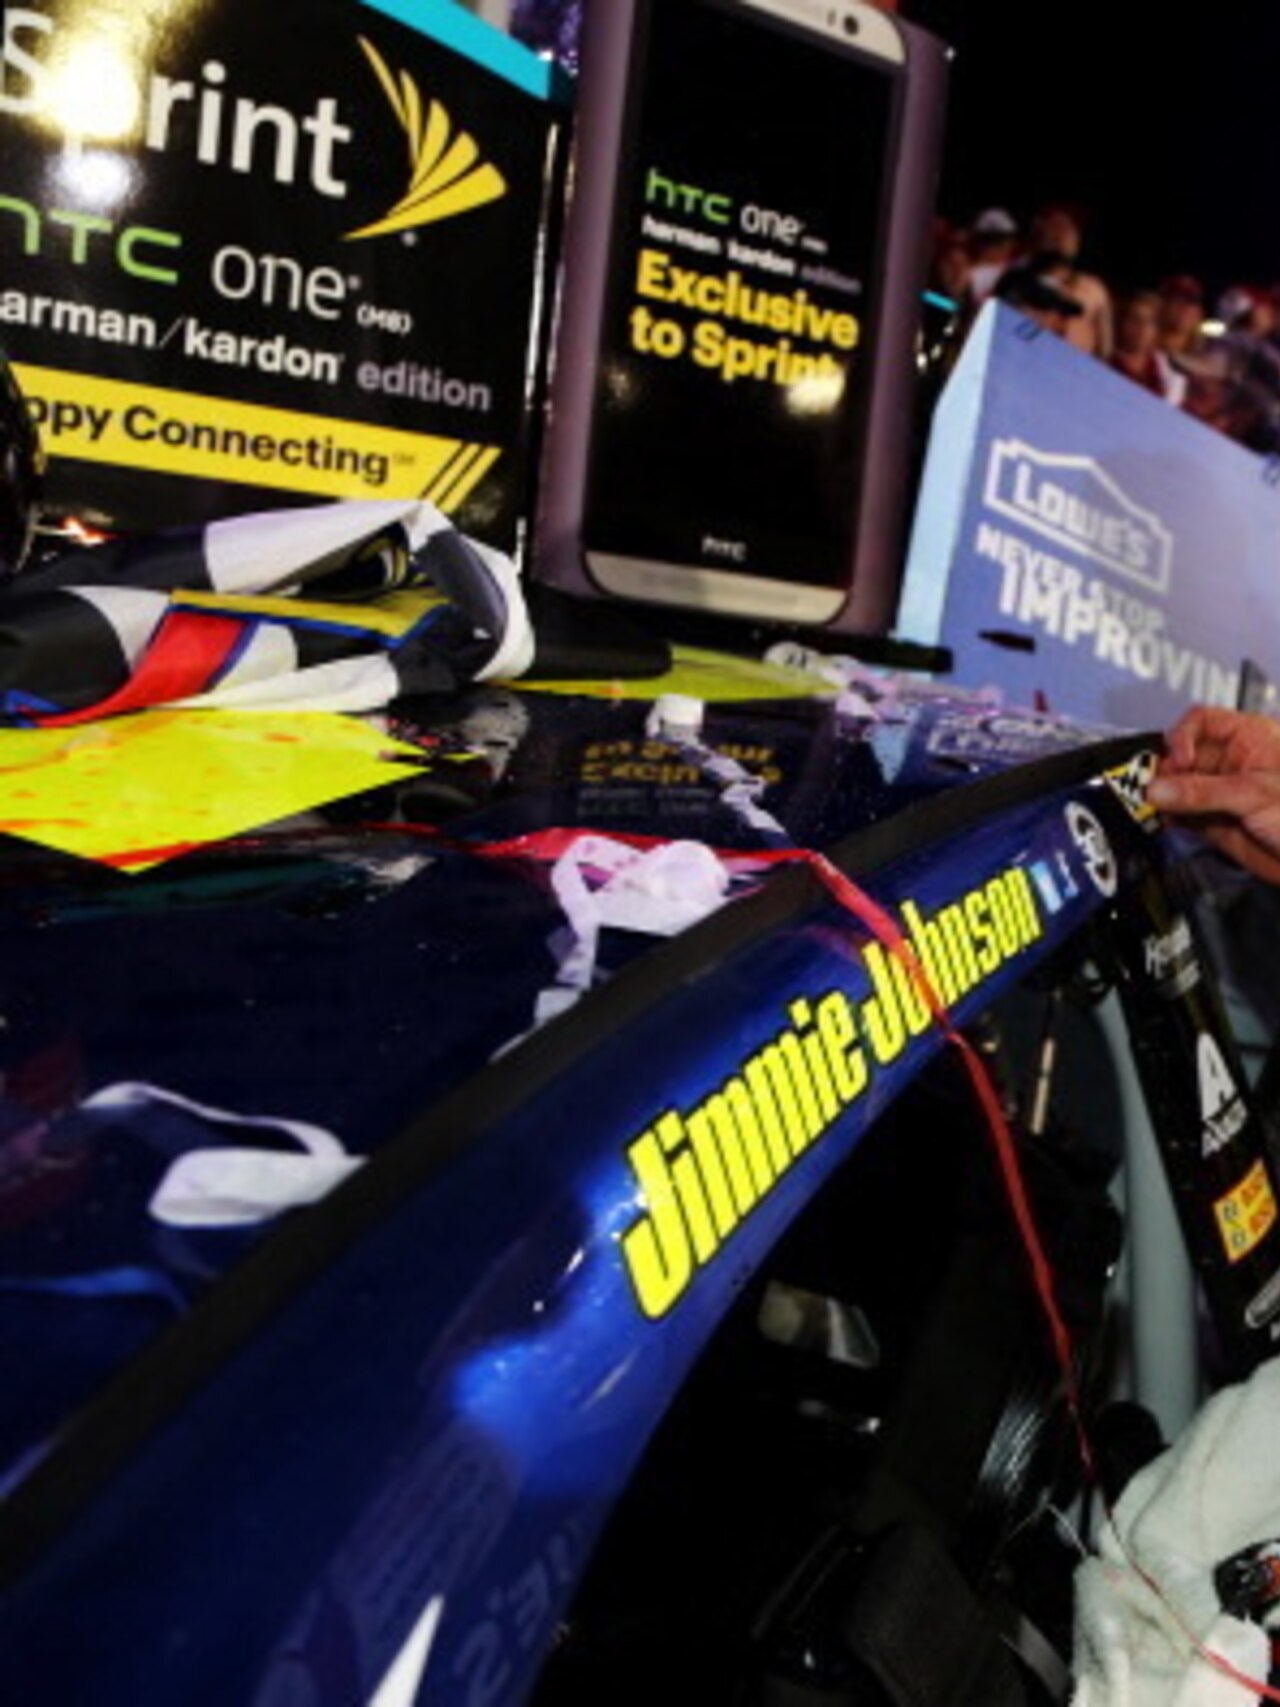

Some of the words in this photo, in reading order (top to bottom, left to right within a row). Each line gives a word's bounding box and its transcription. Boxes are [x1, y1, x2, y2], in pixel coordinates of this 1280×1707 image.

[0, 8, 350, 197] Srint
[630, 305, 685, 358] to
[637, 249, 859, 348] Exclusive
[356, 359, 491, 411] edition
[123, 405, 389, 487] Connecting
[859, 867, 1042, 1065] Johnson
[621, 989, 869, 1319] Jimmie
